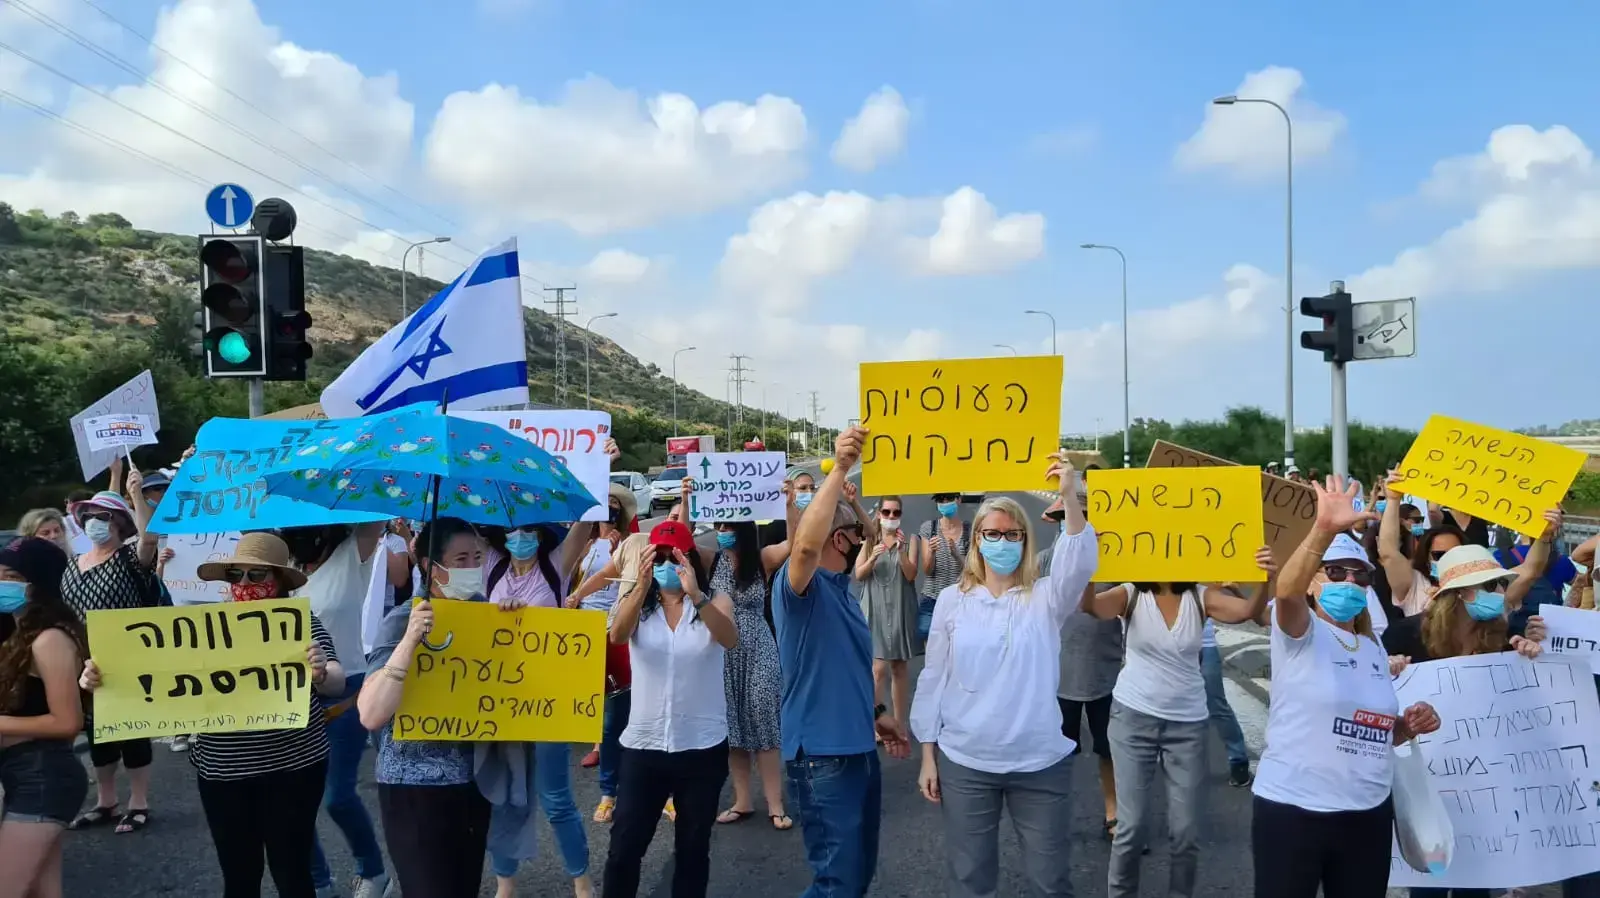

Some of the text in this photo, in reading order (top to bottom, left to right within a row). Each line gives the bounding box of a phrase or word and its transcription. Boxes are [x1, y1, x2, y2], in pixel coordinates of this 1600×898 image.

[863, 433, 1035, 476] נחנקות
[1446, 429, 1535, 464] הנשמה
[189, 445, 293, 484] ותקת
[724, 459, 780, 478] עומס
[1425, 449, 1558, 495] לשירותים
[161, 475, 270, 521] קורסת
[691, 480, 752, 493] מקסימום
[714, 490, 780, 504] משכורת
[1092, 484, 1222, 512] הנשמה
[1403, 468, 1533, 525] החברתיים
[701, 506, 752, 519] מינימום
[1095, 522, 1246, 559] לרווחה
[125, 606, 302, 650] הרווחה
[1551, 636, 1600, 652] דים!!!
[416, 652, 526, 692] זועקים
[478, 694, 601, 719] לא עומדים
[399, 714, 498, 738] בעומסים
[1335, 719, 1387, 741] נחנקים!
[1530, 821, 1600, 849] נשמה
